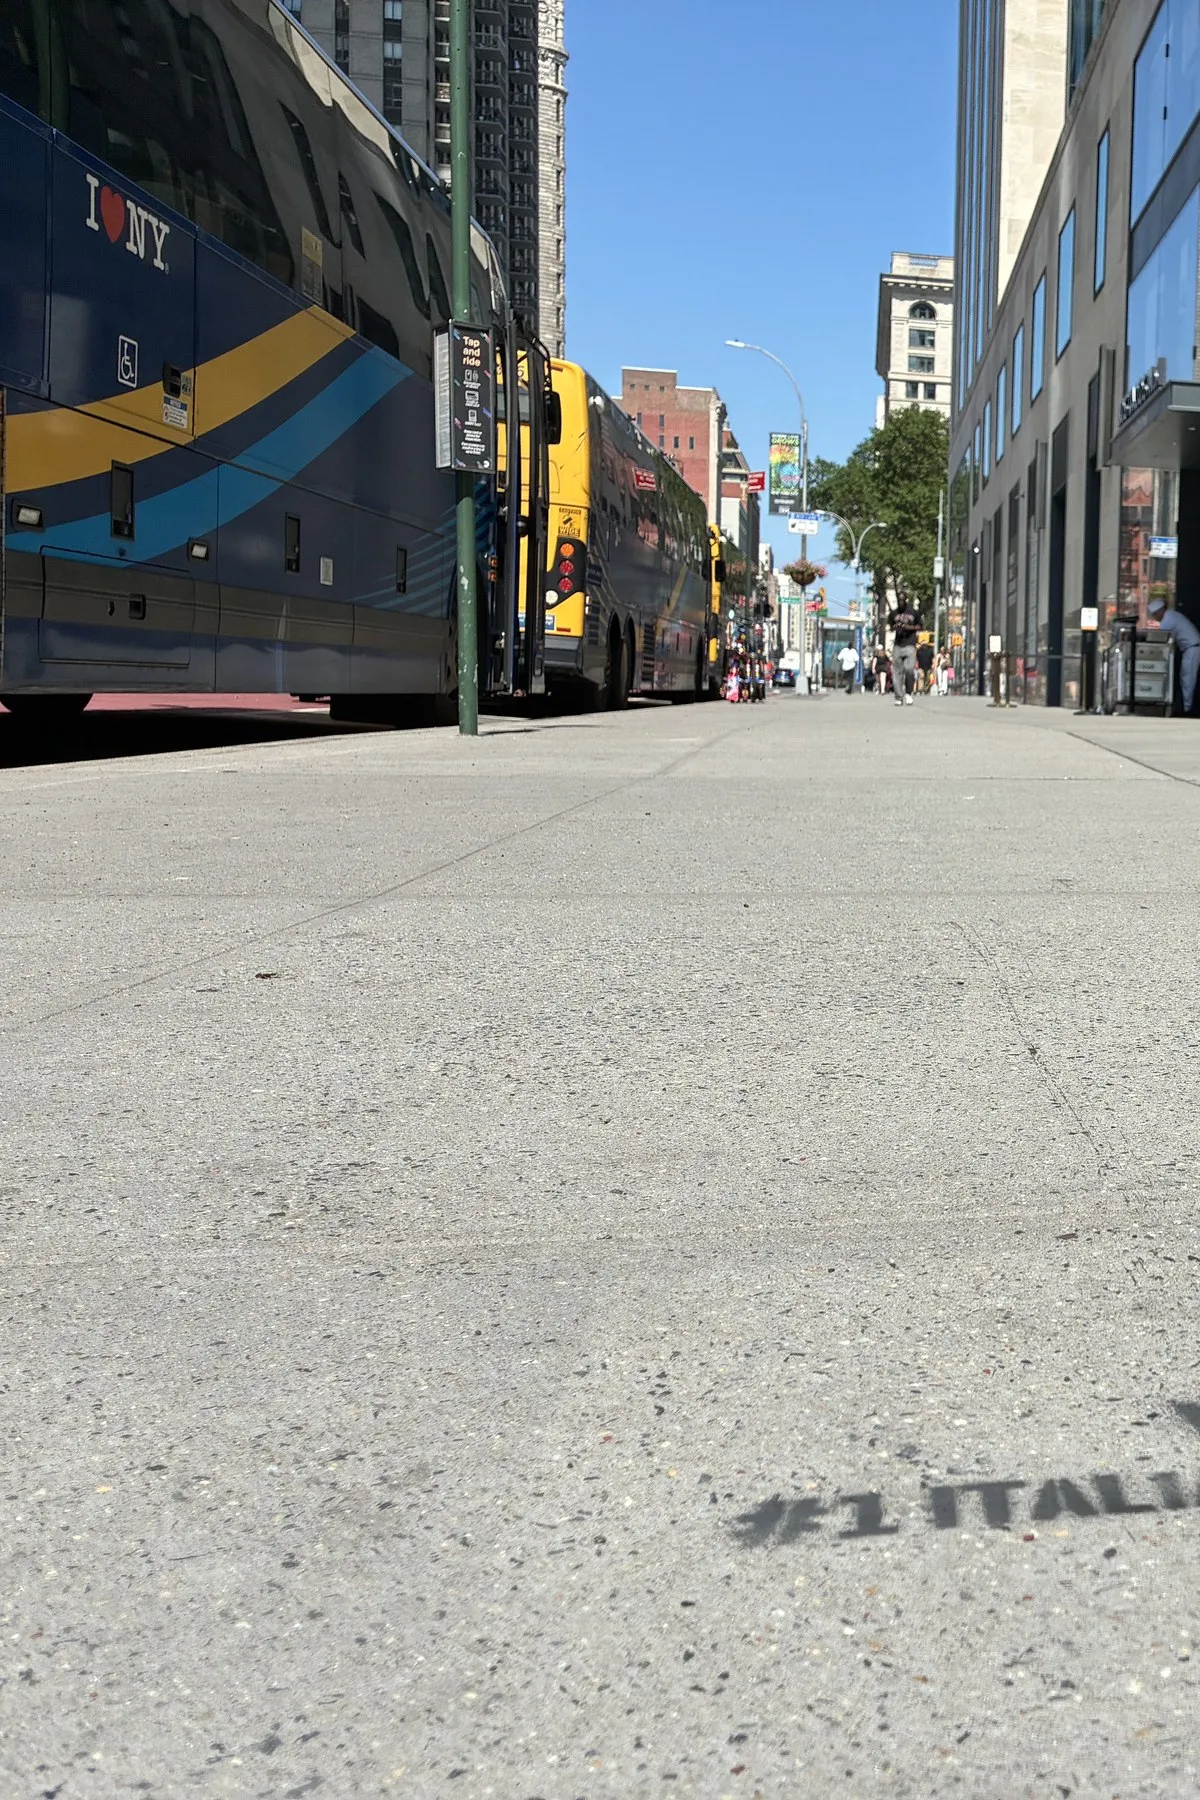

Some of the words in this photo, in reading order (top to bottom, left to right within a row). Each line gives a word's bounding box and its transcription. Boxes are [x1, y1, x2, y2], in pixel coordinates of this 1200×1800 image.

[86, 173, 99, 231] I
[463, 335, 480, 348] Tap
[463, 347, 480, 357] and
[463, 356, 481, 367] ride
[734, 1492, 899, 1546] #1
